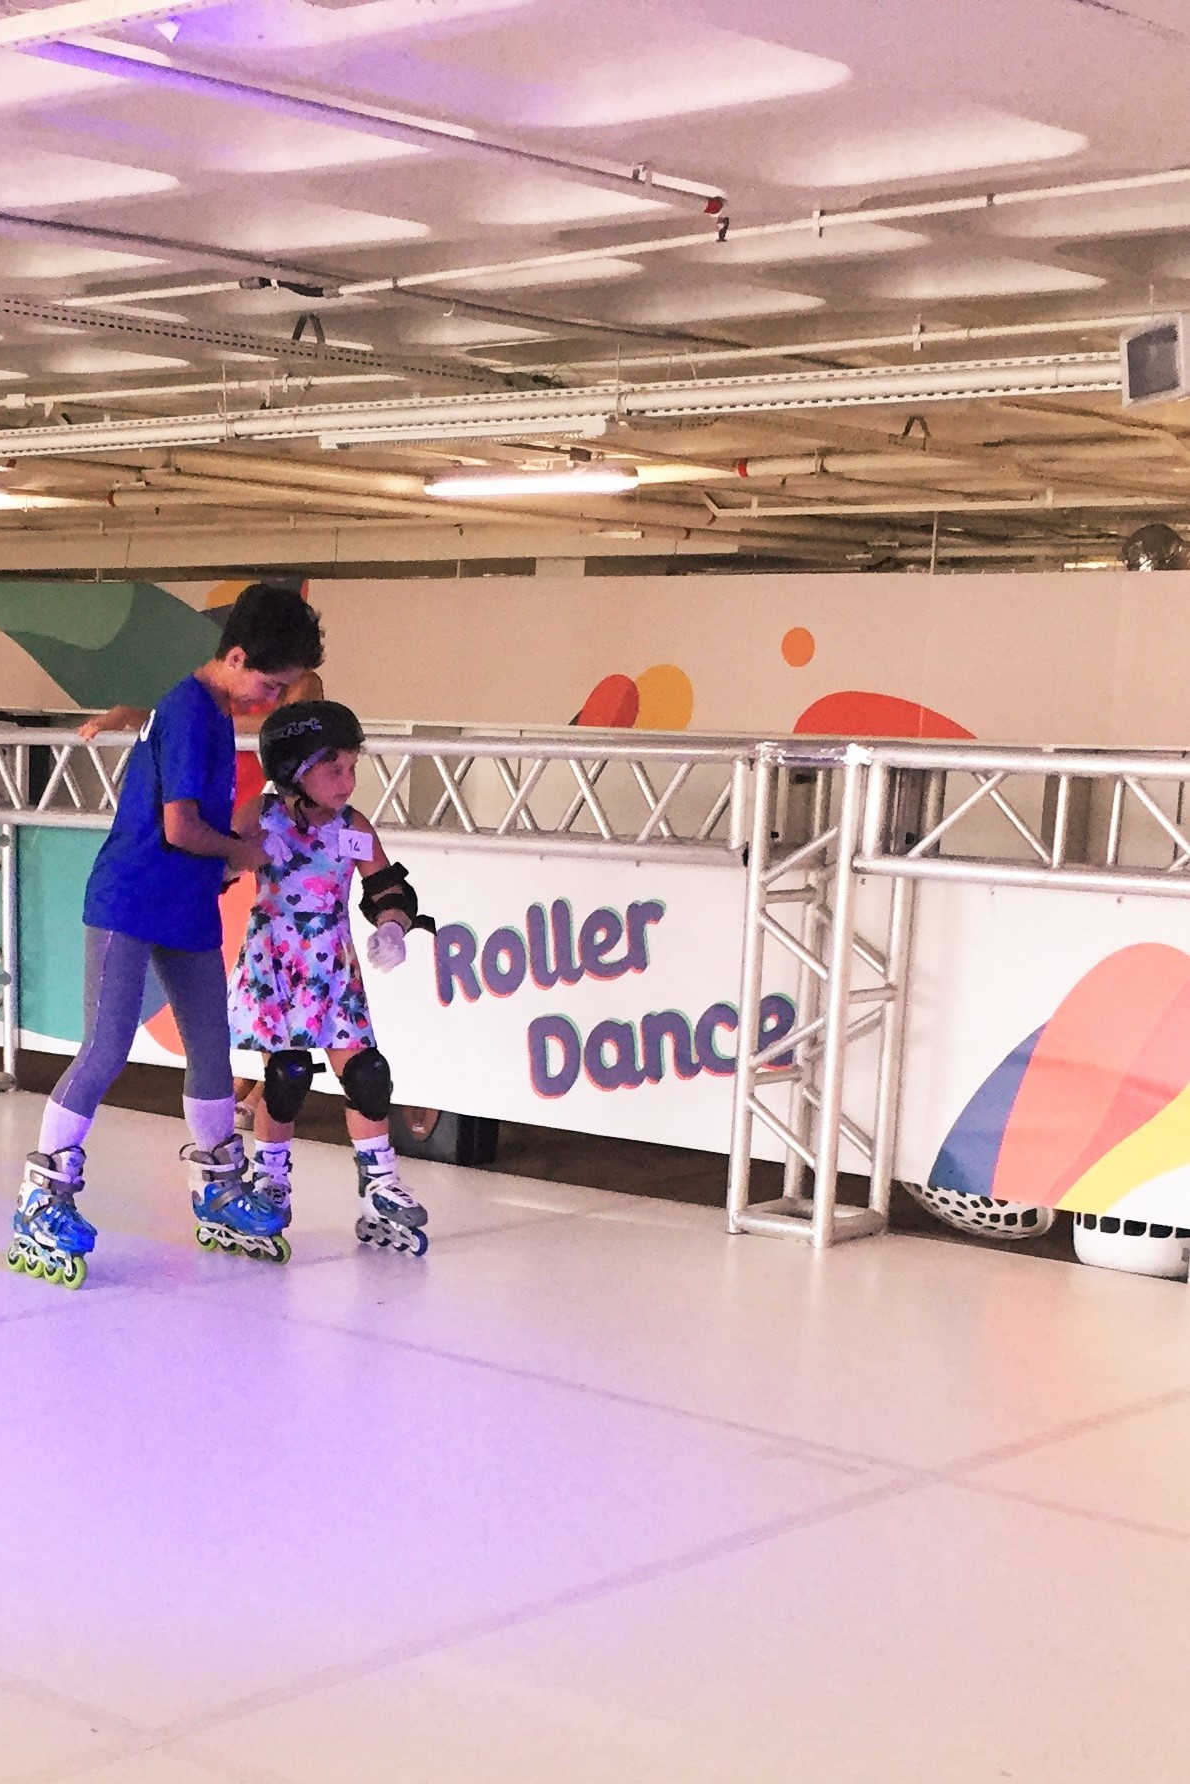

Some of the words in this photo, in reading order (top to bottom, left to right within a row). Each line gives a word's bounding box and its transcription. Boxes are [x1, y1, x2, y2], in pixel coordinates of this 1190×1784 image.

[347, 838, 361, 852] 14
[433, 896, 667, 1007] Roller
[527, 992, 797, 1100] Dance
